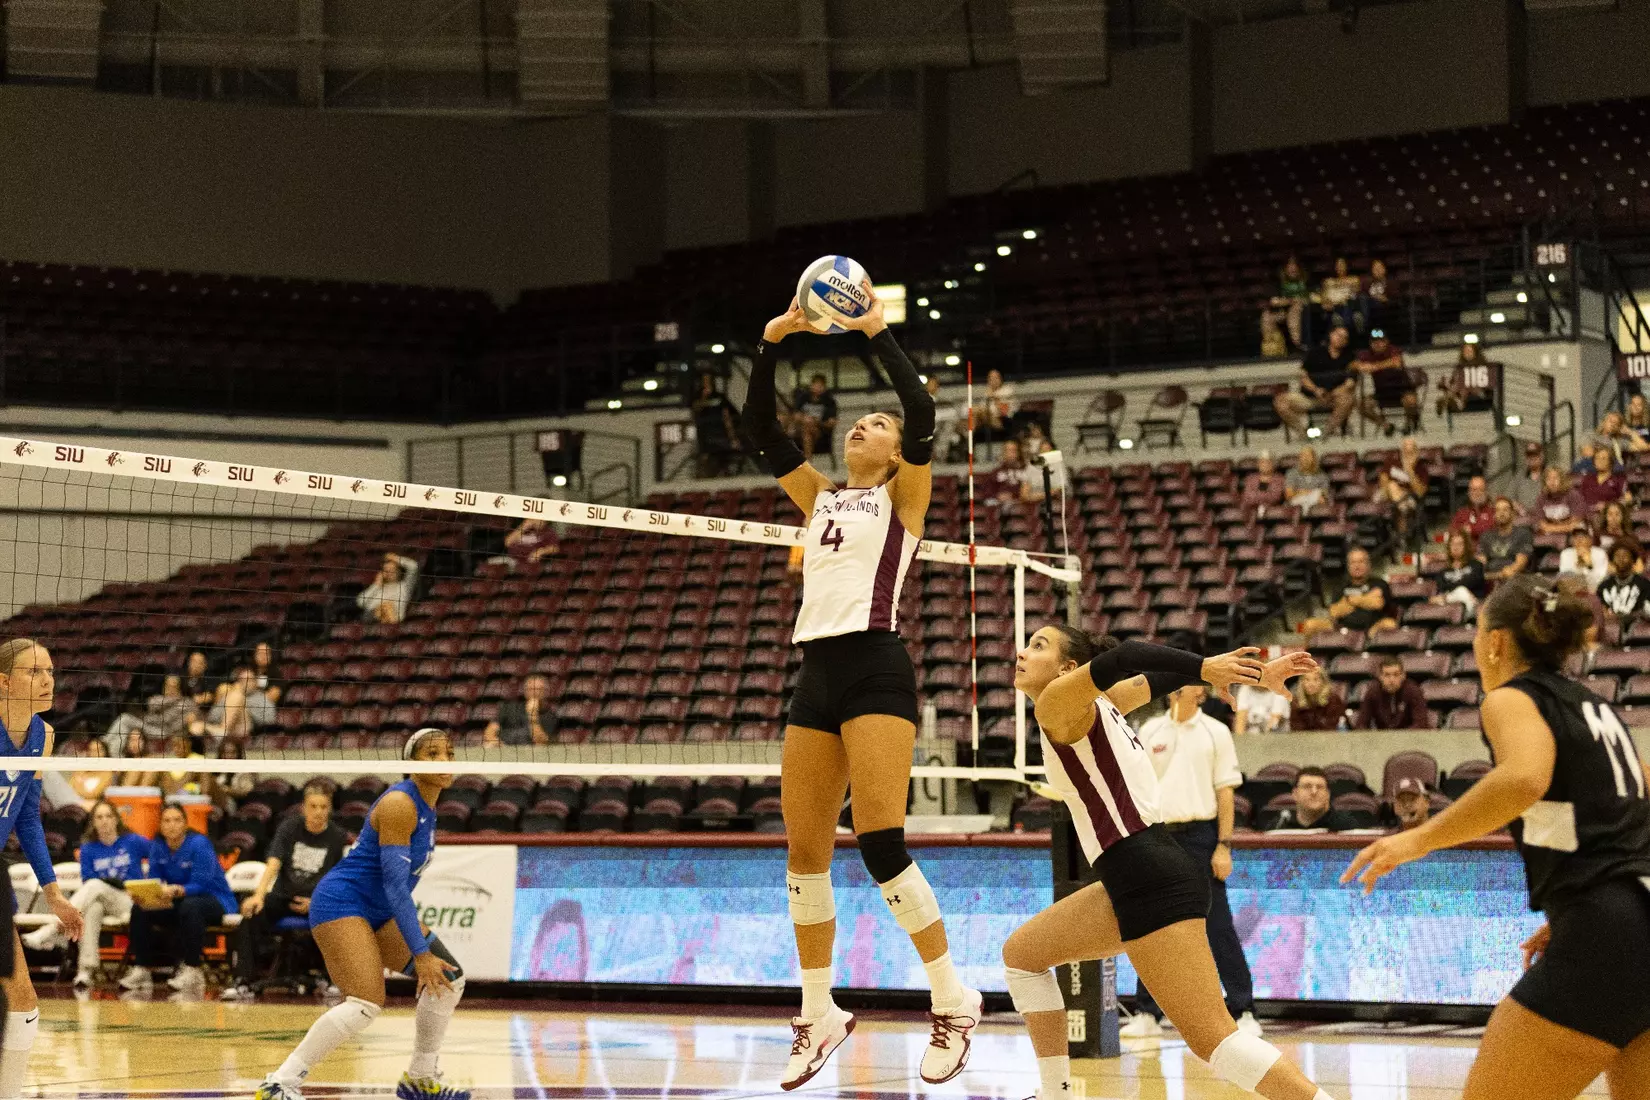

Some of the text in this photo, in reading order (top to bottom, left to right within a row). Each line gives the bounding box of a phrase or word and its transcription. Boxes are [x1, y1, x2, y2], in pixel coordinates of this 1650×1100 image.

[1537, 243, 1566, 265] 216
[828, 275, 866, 305] molten
[1464, 365, 1489, 388] 116
[54, 446, 84, 464] SIU
[143, 456, 172, 474] SIU
[227, 466, 254, 482] SIU
[307, 474, 333, 491] SIU
[382, 483, 407, 499] SIU
[454, 491, 477, 507] SIU
[522, 499, 544, 514] SIU
[586, 506, 608, 521] SIU
[648, 512, 670, 526] SIU
[707, 519, 726, 533] SIU
[763, 524, 782, 539] SIU
[820, 519, 844, 552] 4
